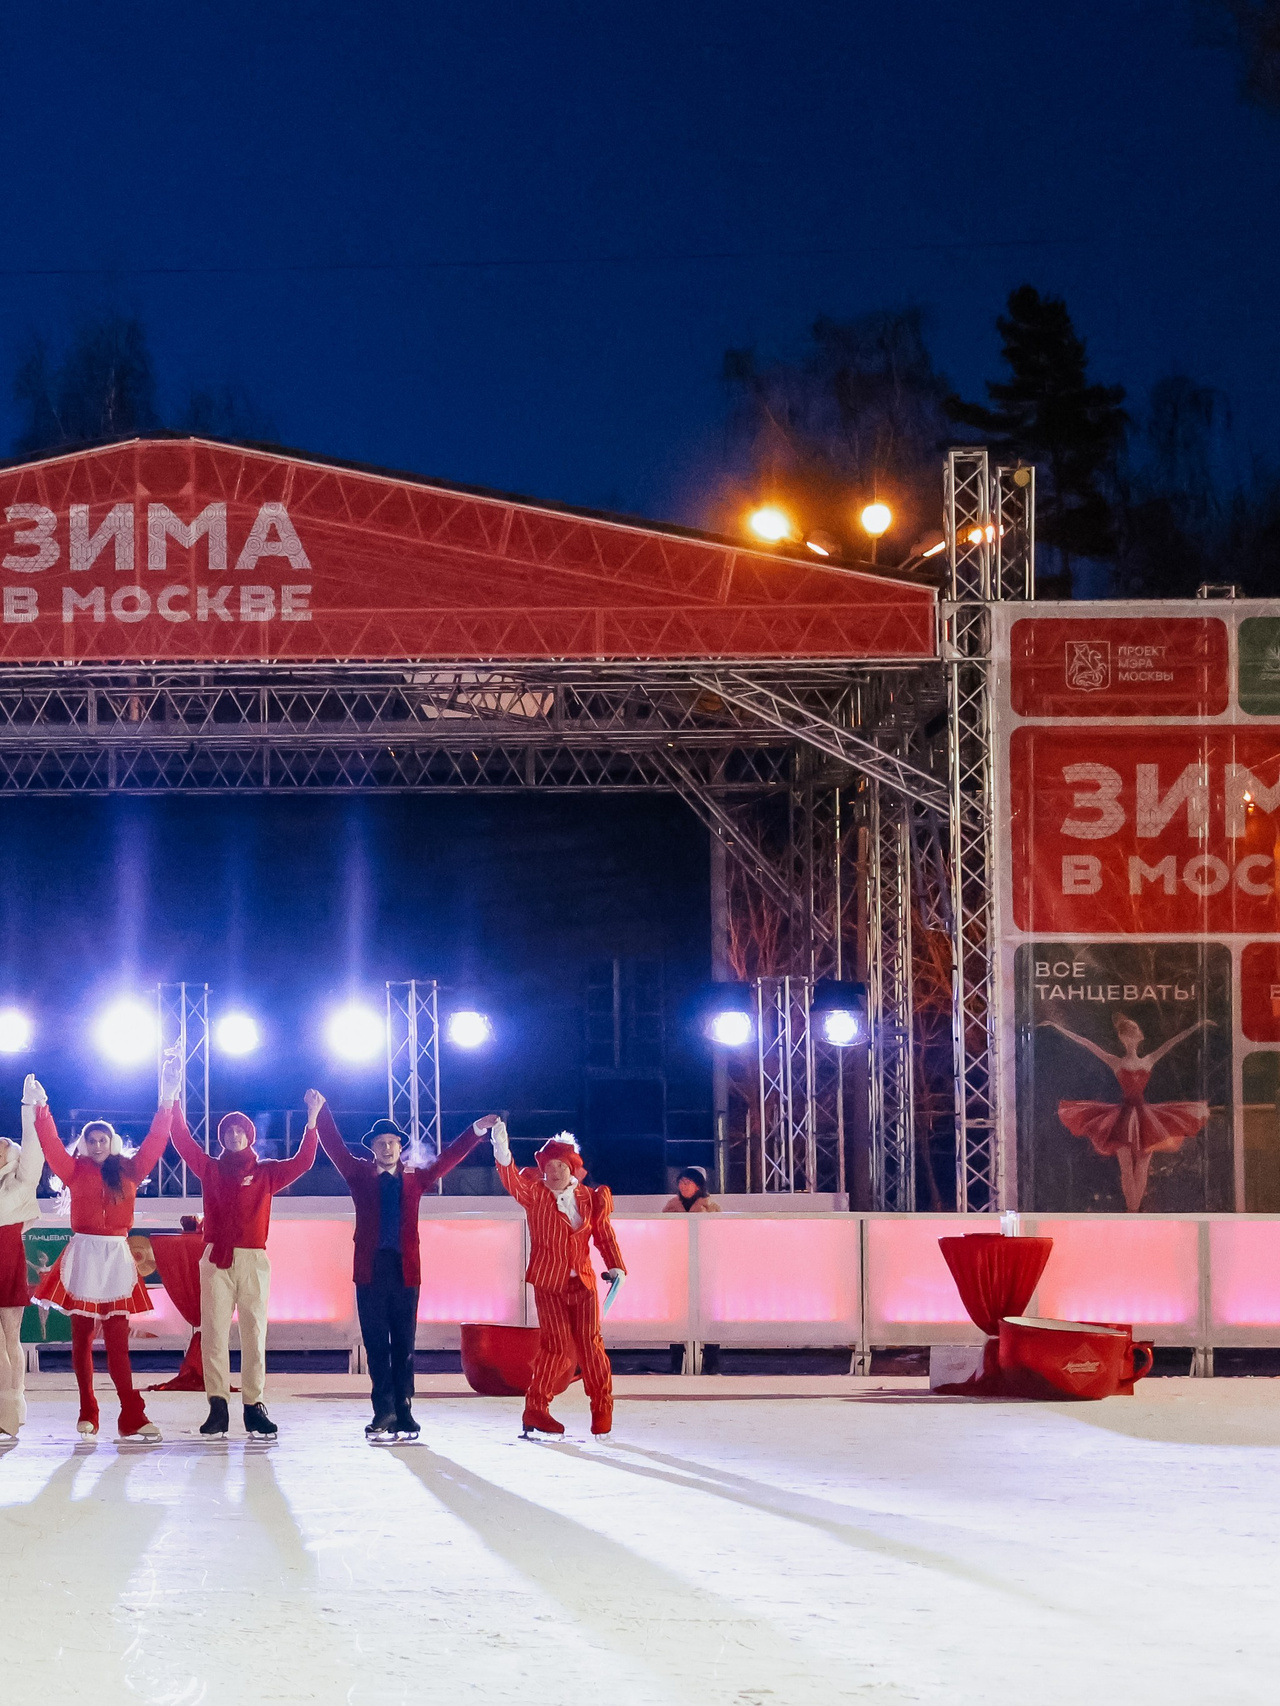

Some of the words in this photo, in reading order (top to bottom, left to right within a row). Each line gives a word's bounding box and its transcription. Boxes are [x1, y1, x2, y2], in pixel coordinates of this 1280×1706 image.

[1, 502, 312, 573] ЗИМА
[2, 586, 39, 623] В
[62, 584, 313, 623] МОСКВЕ
[1118, 646, 1167, 657] ПРОЕКТ
[1118, 658, 1154, 669] МЭРА
[1118, 671, 1174, 681] МОСКВЫ
[1060, 762, 1280, 840] ЗИМ
[1062, 855, 1103, 895] В
[1128, 854, 1274, 896] МОС
[1035, 962, 1086, 977] ВСЕ
[1035, 984, 1196, 1003] ТАНЦЕВАТЬ!
[28, 1234, 71, 1242] ТАНЦЕВАТ
